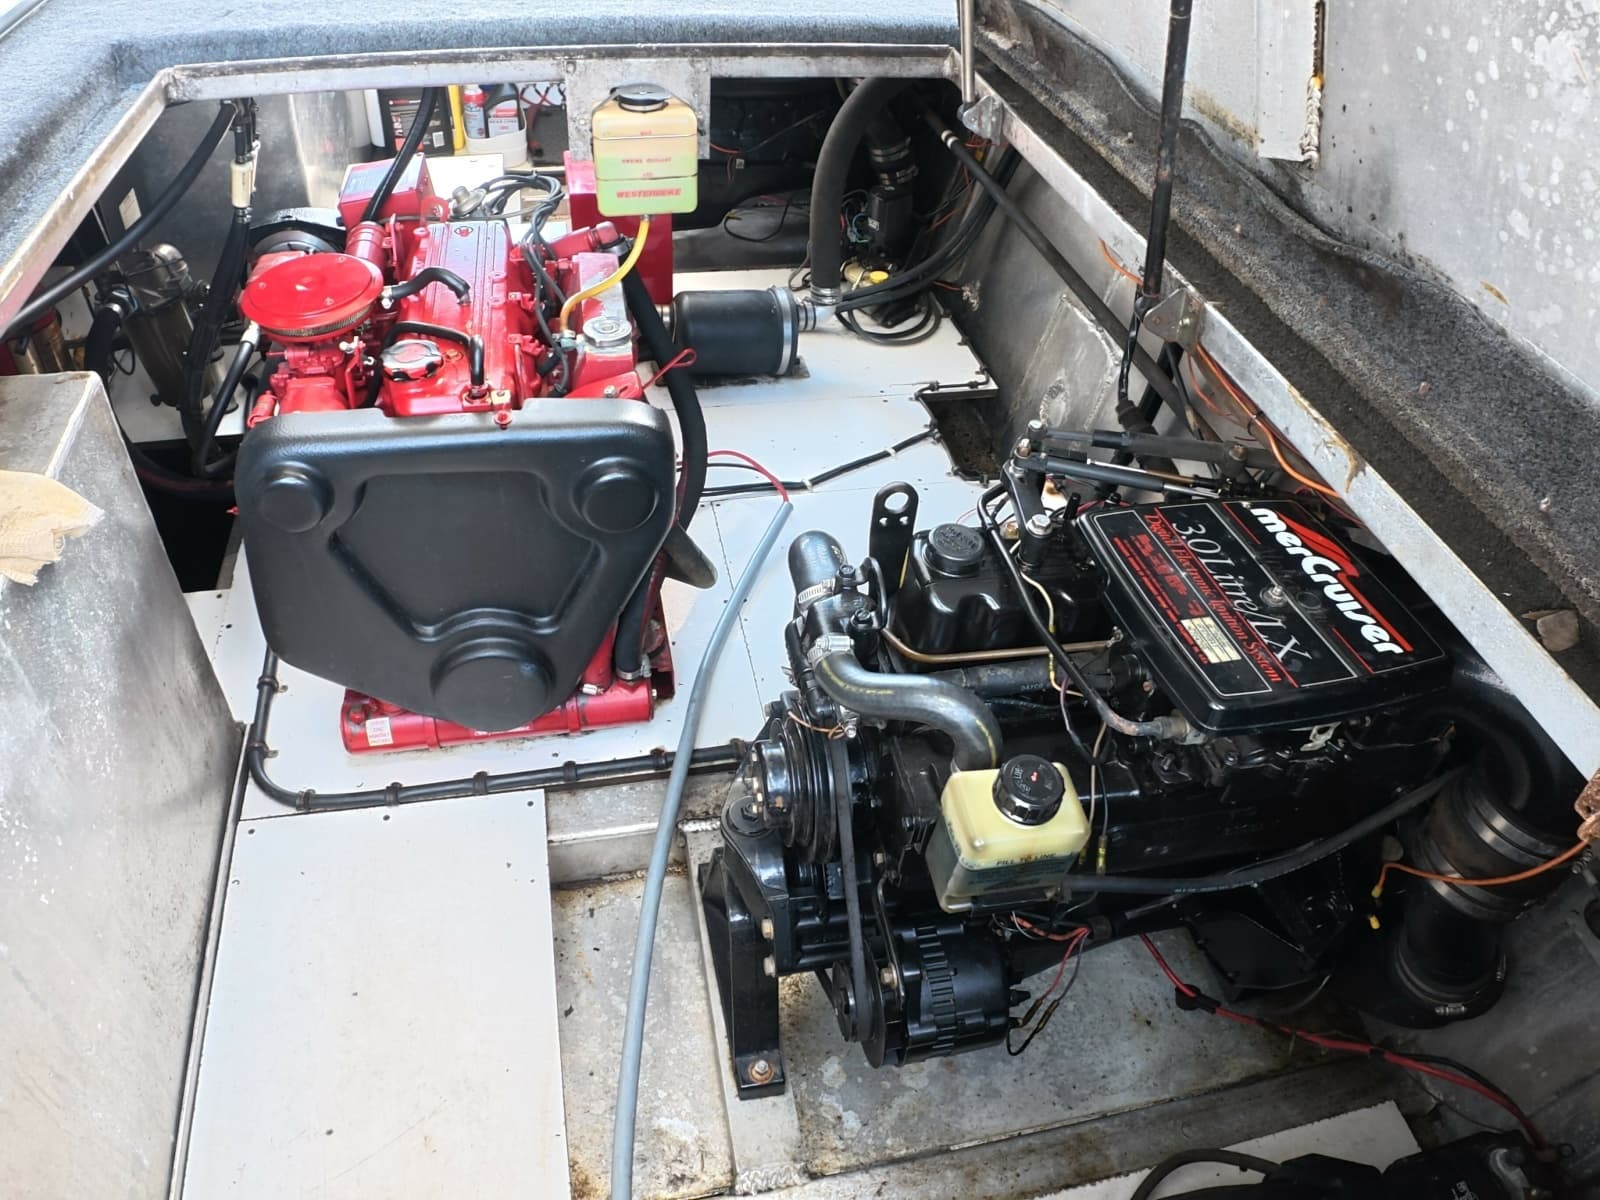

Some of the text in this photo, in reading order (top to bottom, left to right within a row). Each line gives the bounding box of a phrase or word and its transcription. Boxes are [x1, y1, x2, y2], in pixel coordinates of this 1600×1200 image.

[1173, 543, 1215, 597] Electronic
[1209, 598, 1249, 641] Ignition
[1244, 638, 1282, 682] System
[996, 858, 1015, 866] FILL
